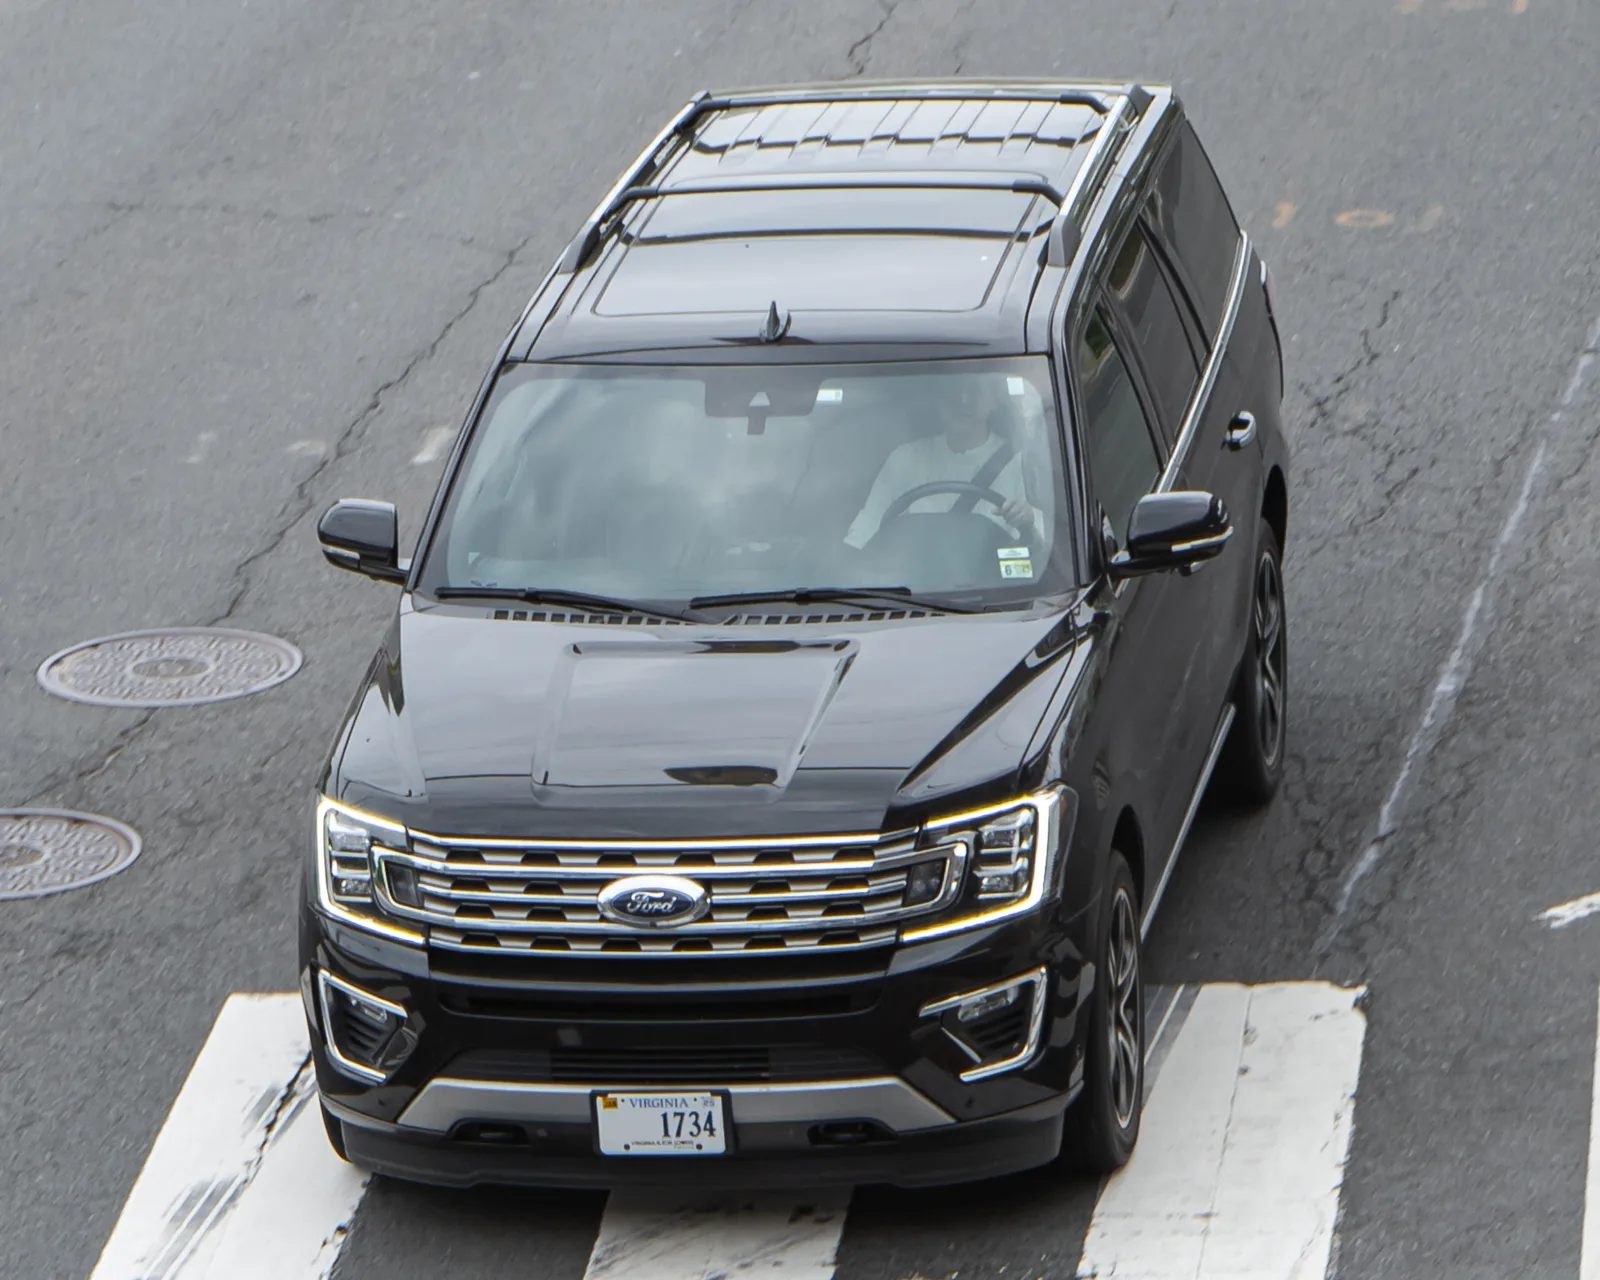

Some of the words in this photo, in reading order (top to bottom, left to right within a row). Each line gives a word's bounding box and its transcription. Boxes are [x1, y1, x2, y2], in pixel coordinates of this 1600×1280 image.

[626, 891, 677, 913] Ford
[629, 1097, 689, 1109] VIRGINIA
[660, 1110, 717, 1138] 1734
